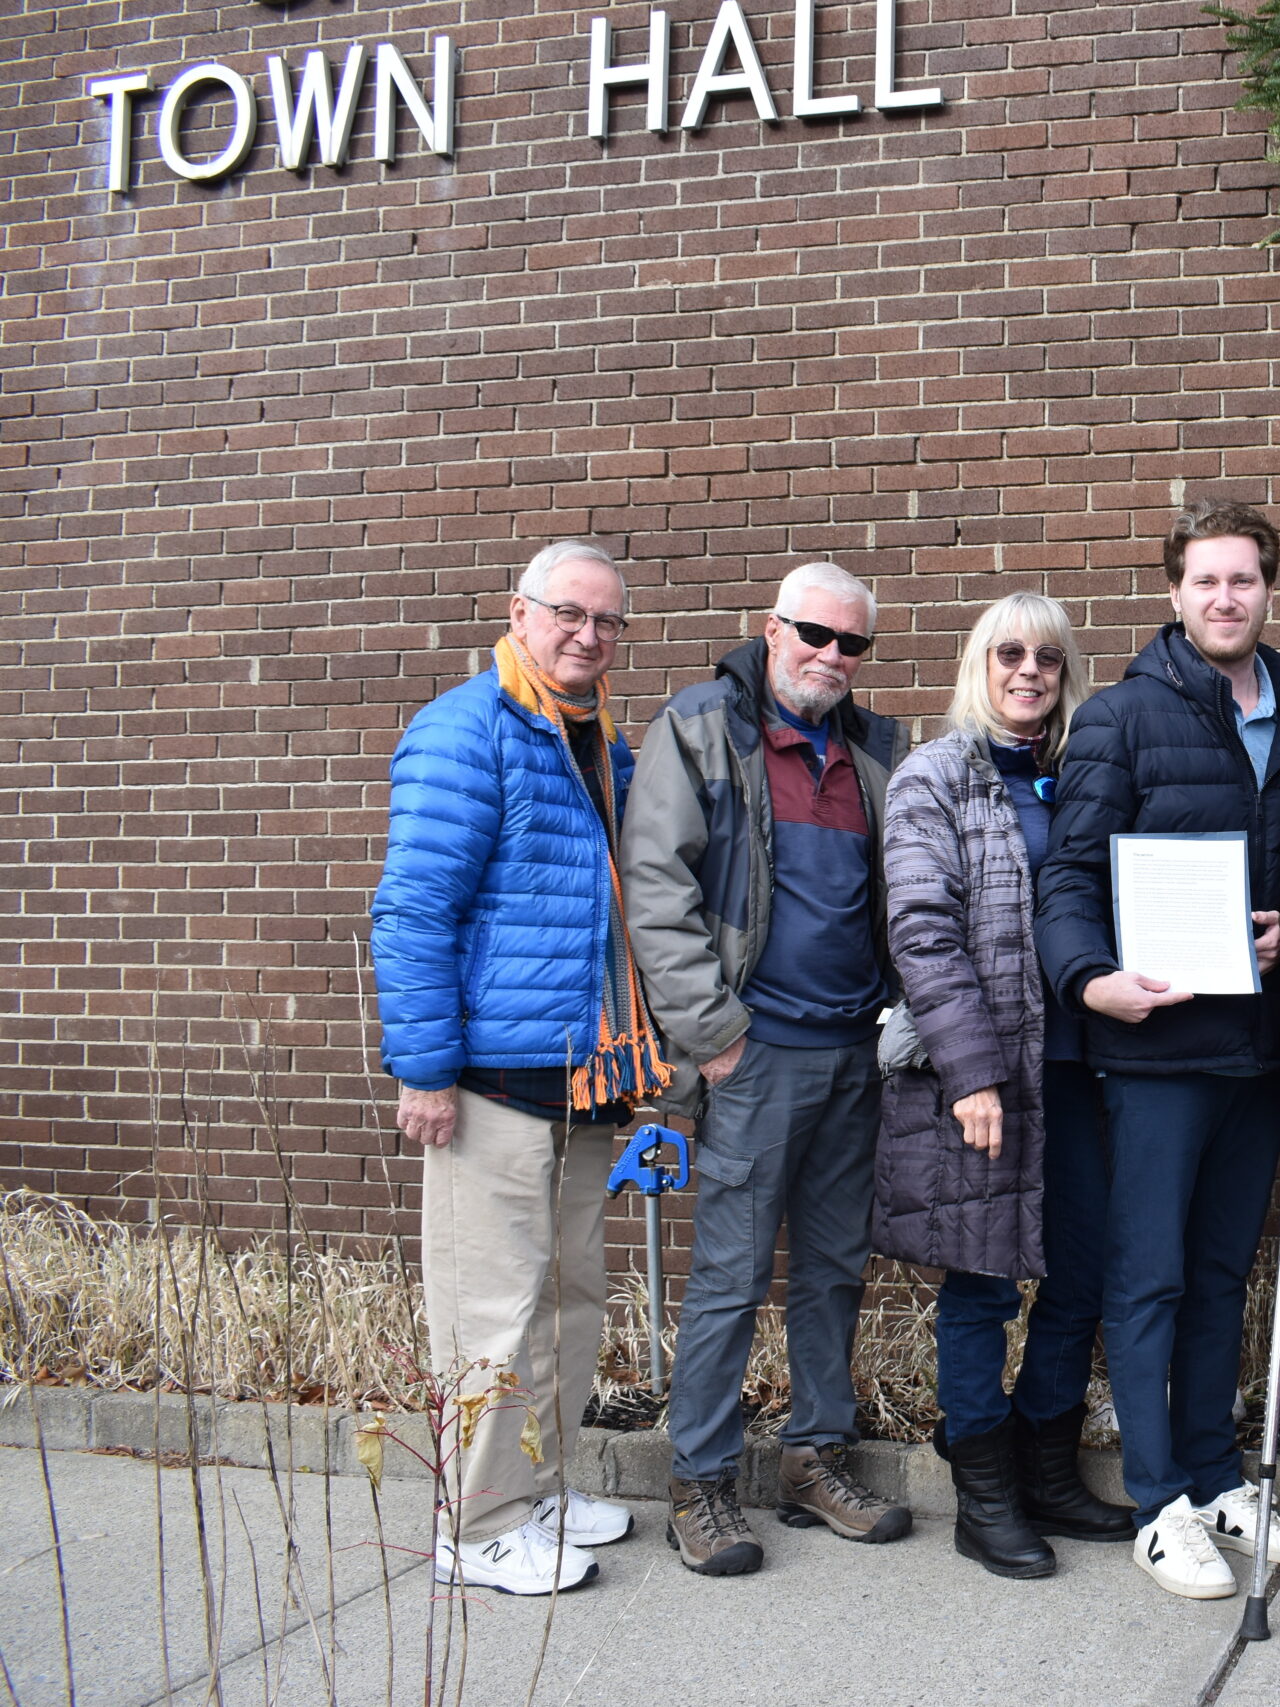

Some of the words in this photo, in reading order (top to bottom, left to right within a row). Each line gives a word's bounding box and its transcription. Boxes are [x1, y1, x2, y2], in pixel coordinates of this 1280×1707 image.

[90, 35, 455, 193] TOWN
[588, 0, 944, 138] HALL
[480, 1539, 514, 1566] N
